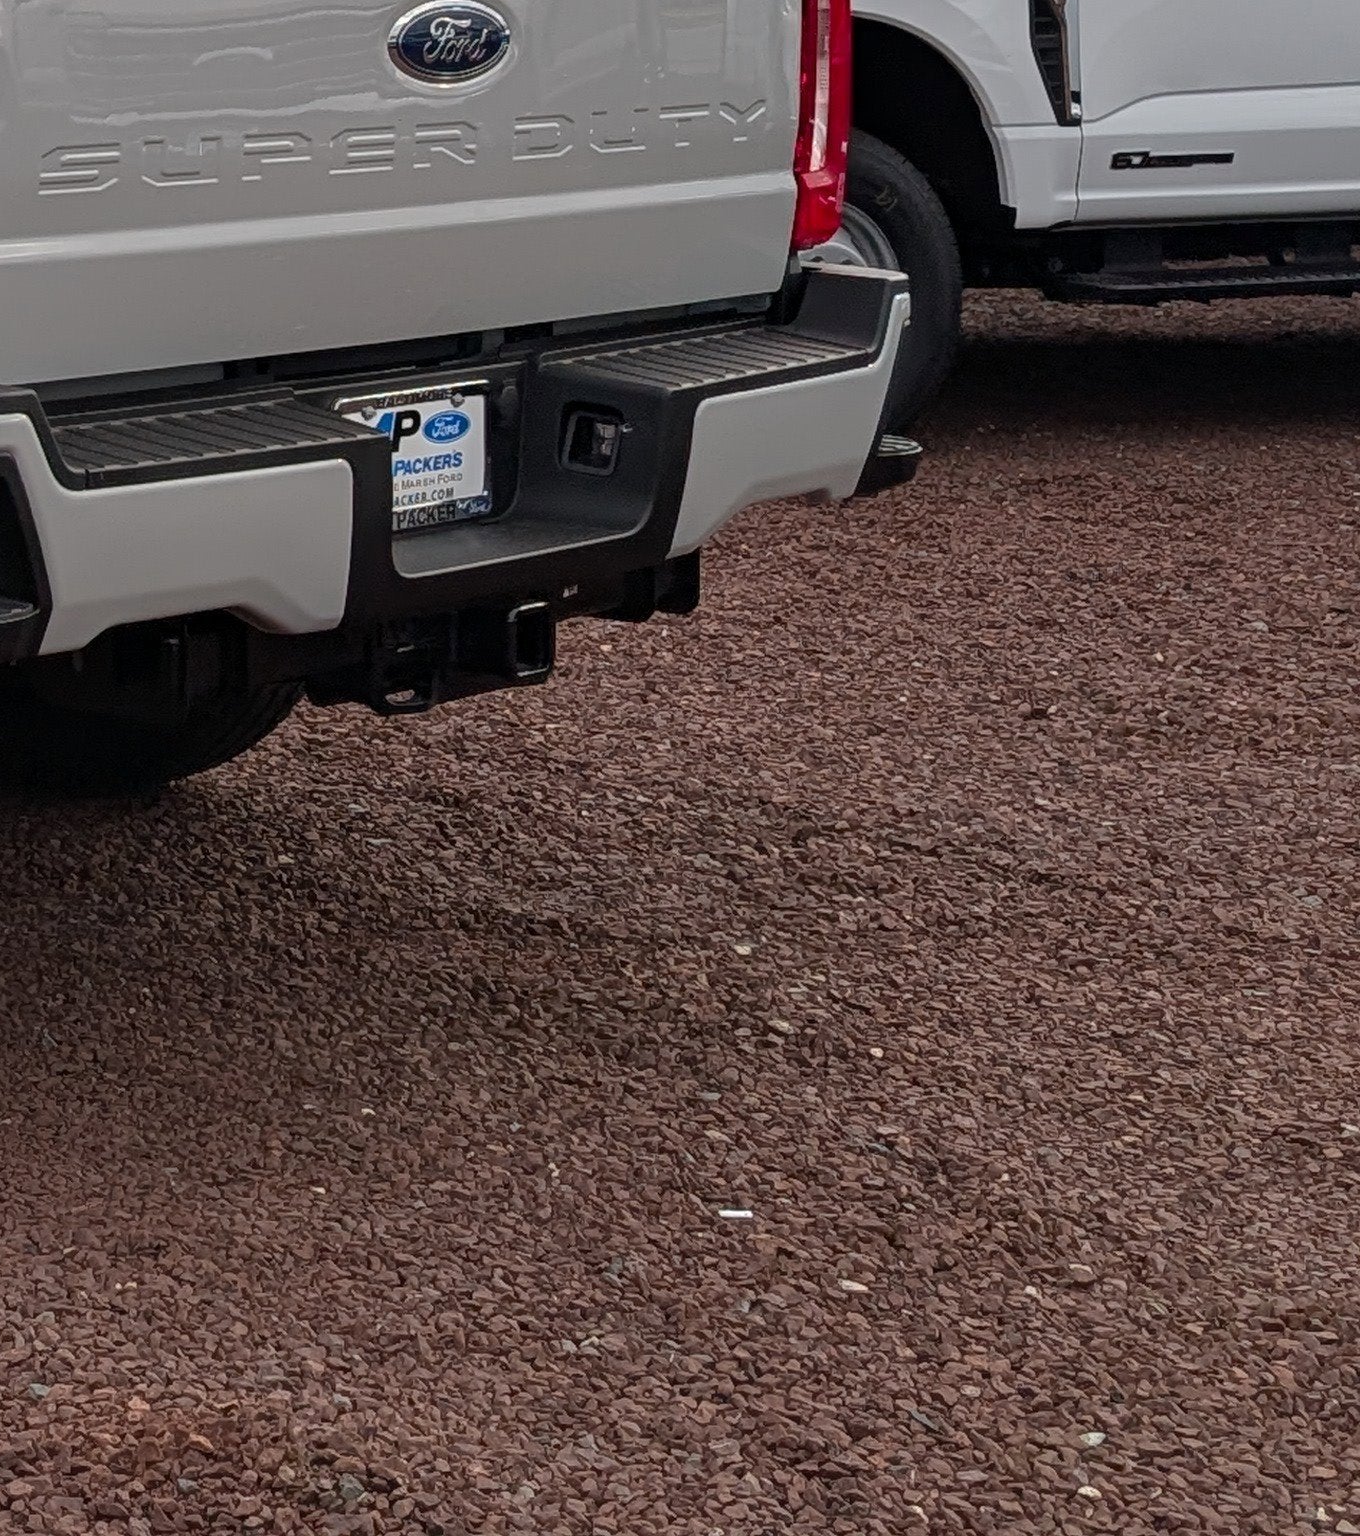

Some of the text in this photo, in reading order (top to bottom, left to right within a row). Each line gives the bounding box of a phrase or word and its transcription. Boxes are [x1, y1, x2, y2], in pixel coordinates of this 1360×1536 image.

[423, 16, 489, 64] Ford
[38, 98, 767, 195] SUPER DUTY
[437, 472, 464, 484] FORD
